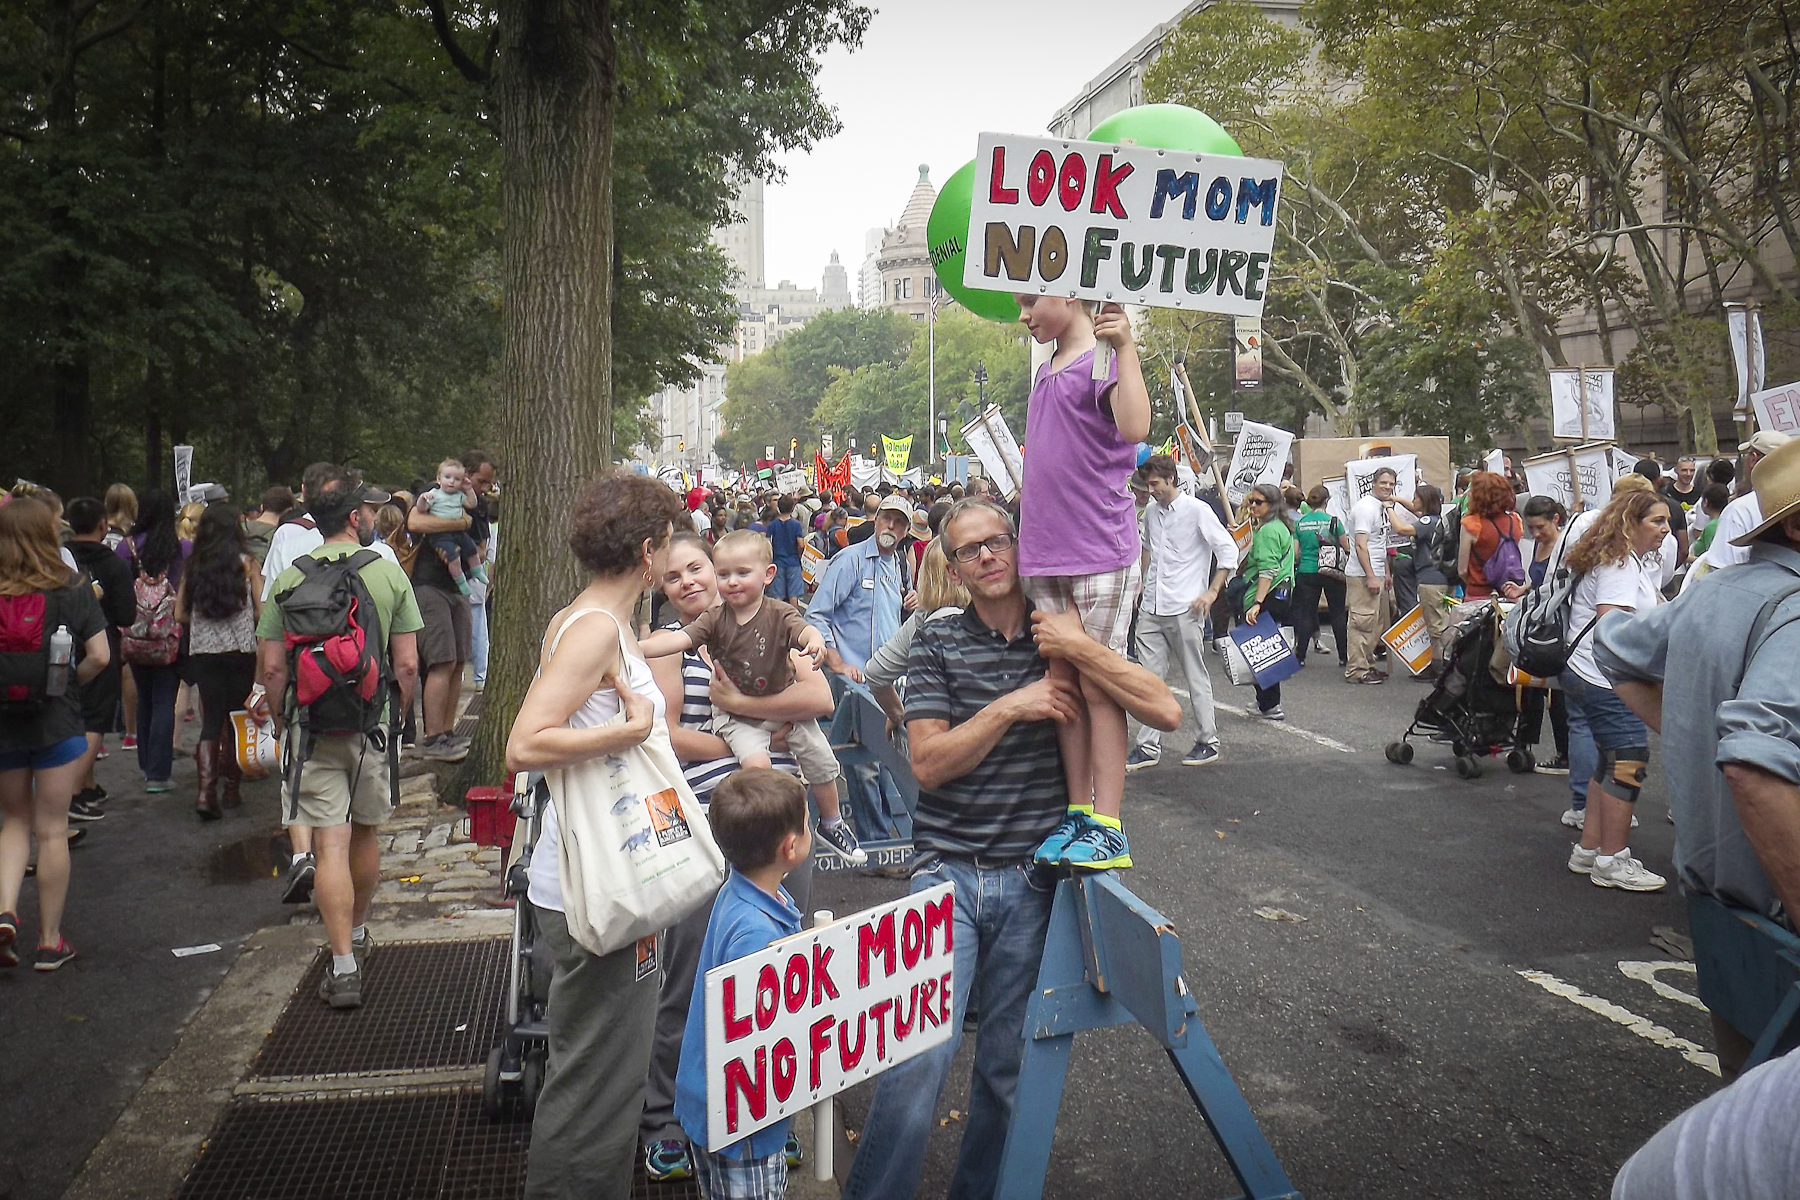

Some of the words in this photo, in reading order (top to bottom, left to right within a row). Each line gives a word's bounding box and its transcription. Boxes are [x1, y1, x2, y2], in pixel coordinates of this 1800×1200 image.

[989, 146, 1135, 220] LOOK
[1149, 168, 1278, 226] MOM
[930, 235, 962, 268] DENIAL
[983, 222, 1069, 282] NO
[1080, 226, 1269, 300] FUTURE
[1245, 441, 1273, 450] FUNDING
[1247, 435, 1263, 443] STOP
[1242, 448, 1267, 457] FOSSILS
[1240, 635, 1263, 651] STOP
[1244, 633, 1282, 658] FUNDING
[1247, 642, 1283, 666] FOSSILS
[722, 943, 840, 1043] LOOK
[857, 892, 955, 990] MOM
[724, 1037, 797, 1134] NO
[810, 971, 952, 1092] FUTURE
